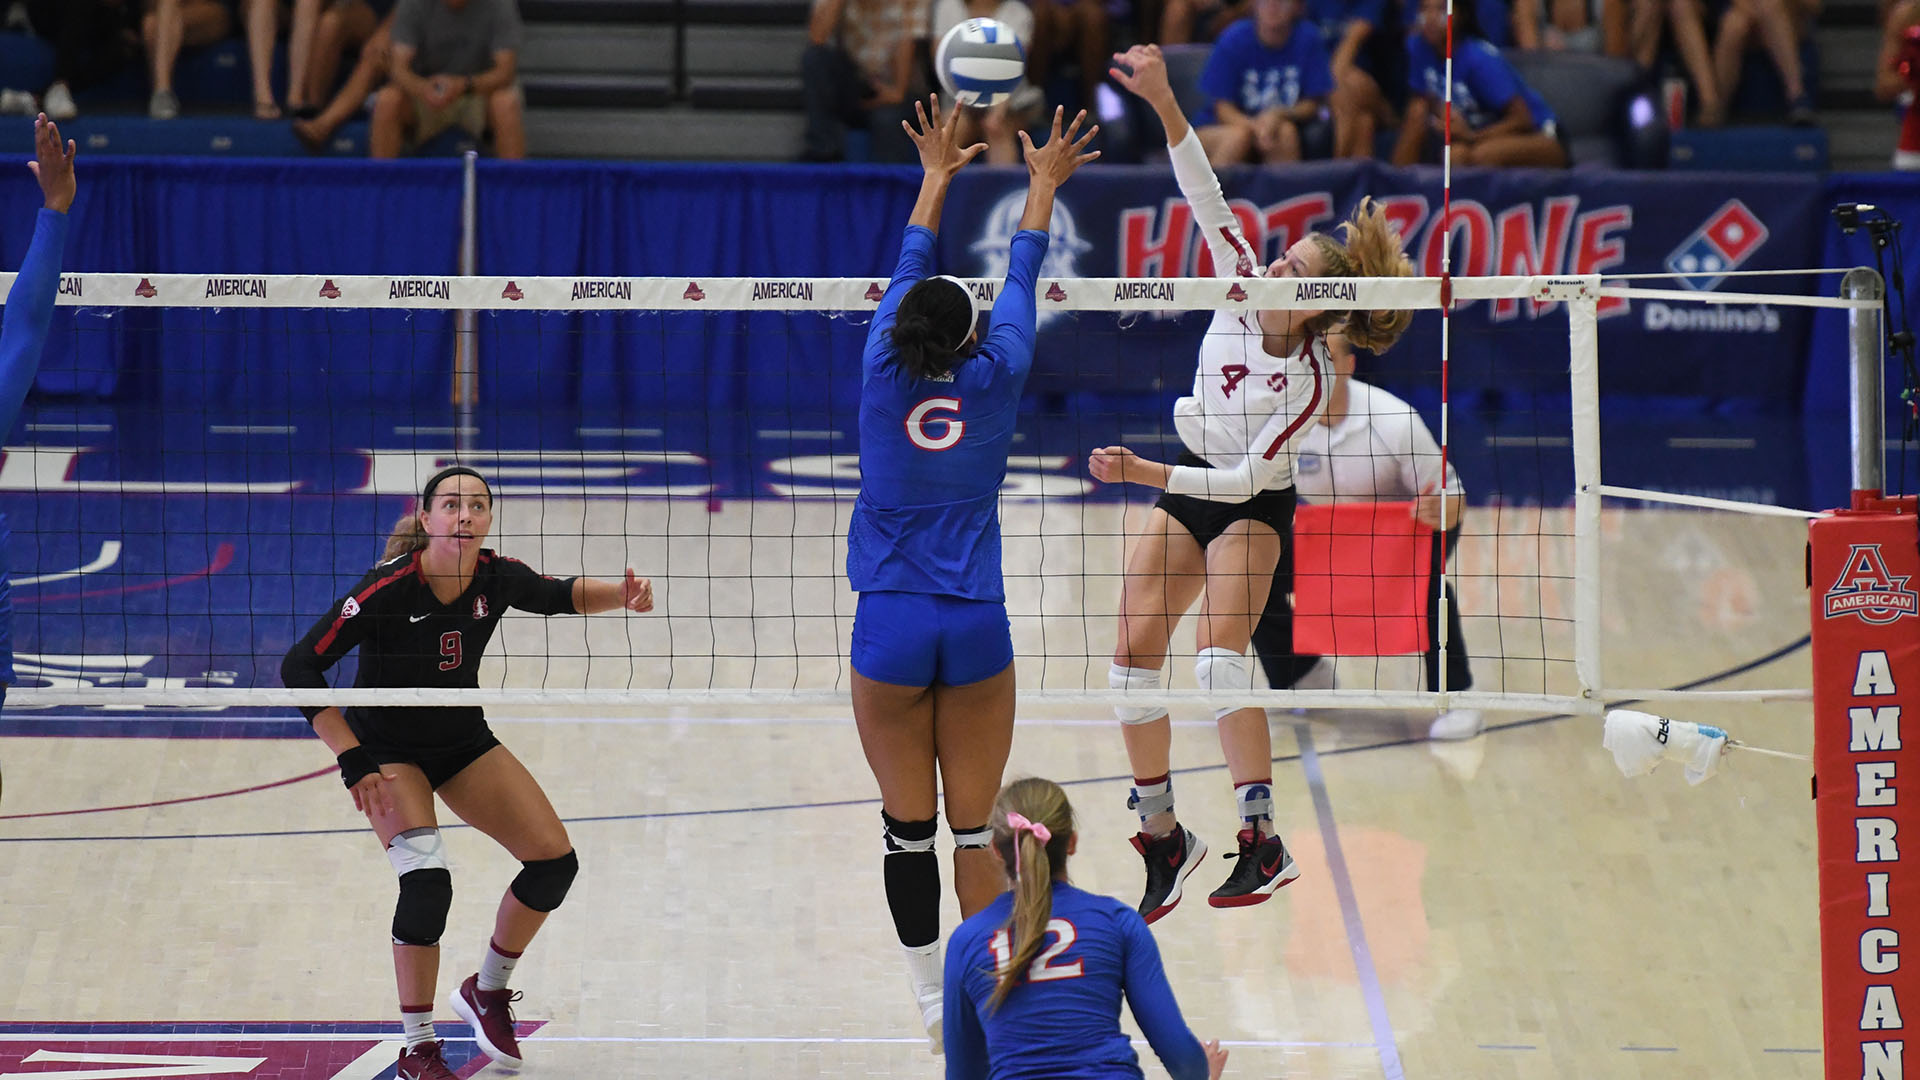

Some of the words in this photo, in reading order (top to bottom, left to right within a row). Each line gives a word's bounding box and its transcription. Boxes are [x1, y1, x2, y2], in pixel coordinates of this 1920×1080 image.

[206, 279, 267, 299] AMERICAN
[389, 280, 450, 300] AMERICAN
[571, 281, 632, 301] AMERICAN
[752, 282, 813, 301] AMERICAN
[1114, 282, 1175, 302] AMERICAN
[1295, 282, 1357, 302] AMERICAN
[1644, 301, 1781, 332] Domino's
[1221, 364, 1251, 400] 4
[904, 395, 966, 452] 6
[1831, 594, 1912, 610] AMERICAN
[438, 630, 463, 672] 9
[1848, 650, 1905, 1080] AMERICAN
[988, 917, 1085, 986] 12
